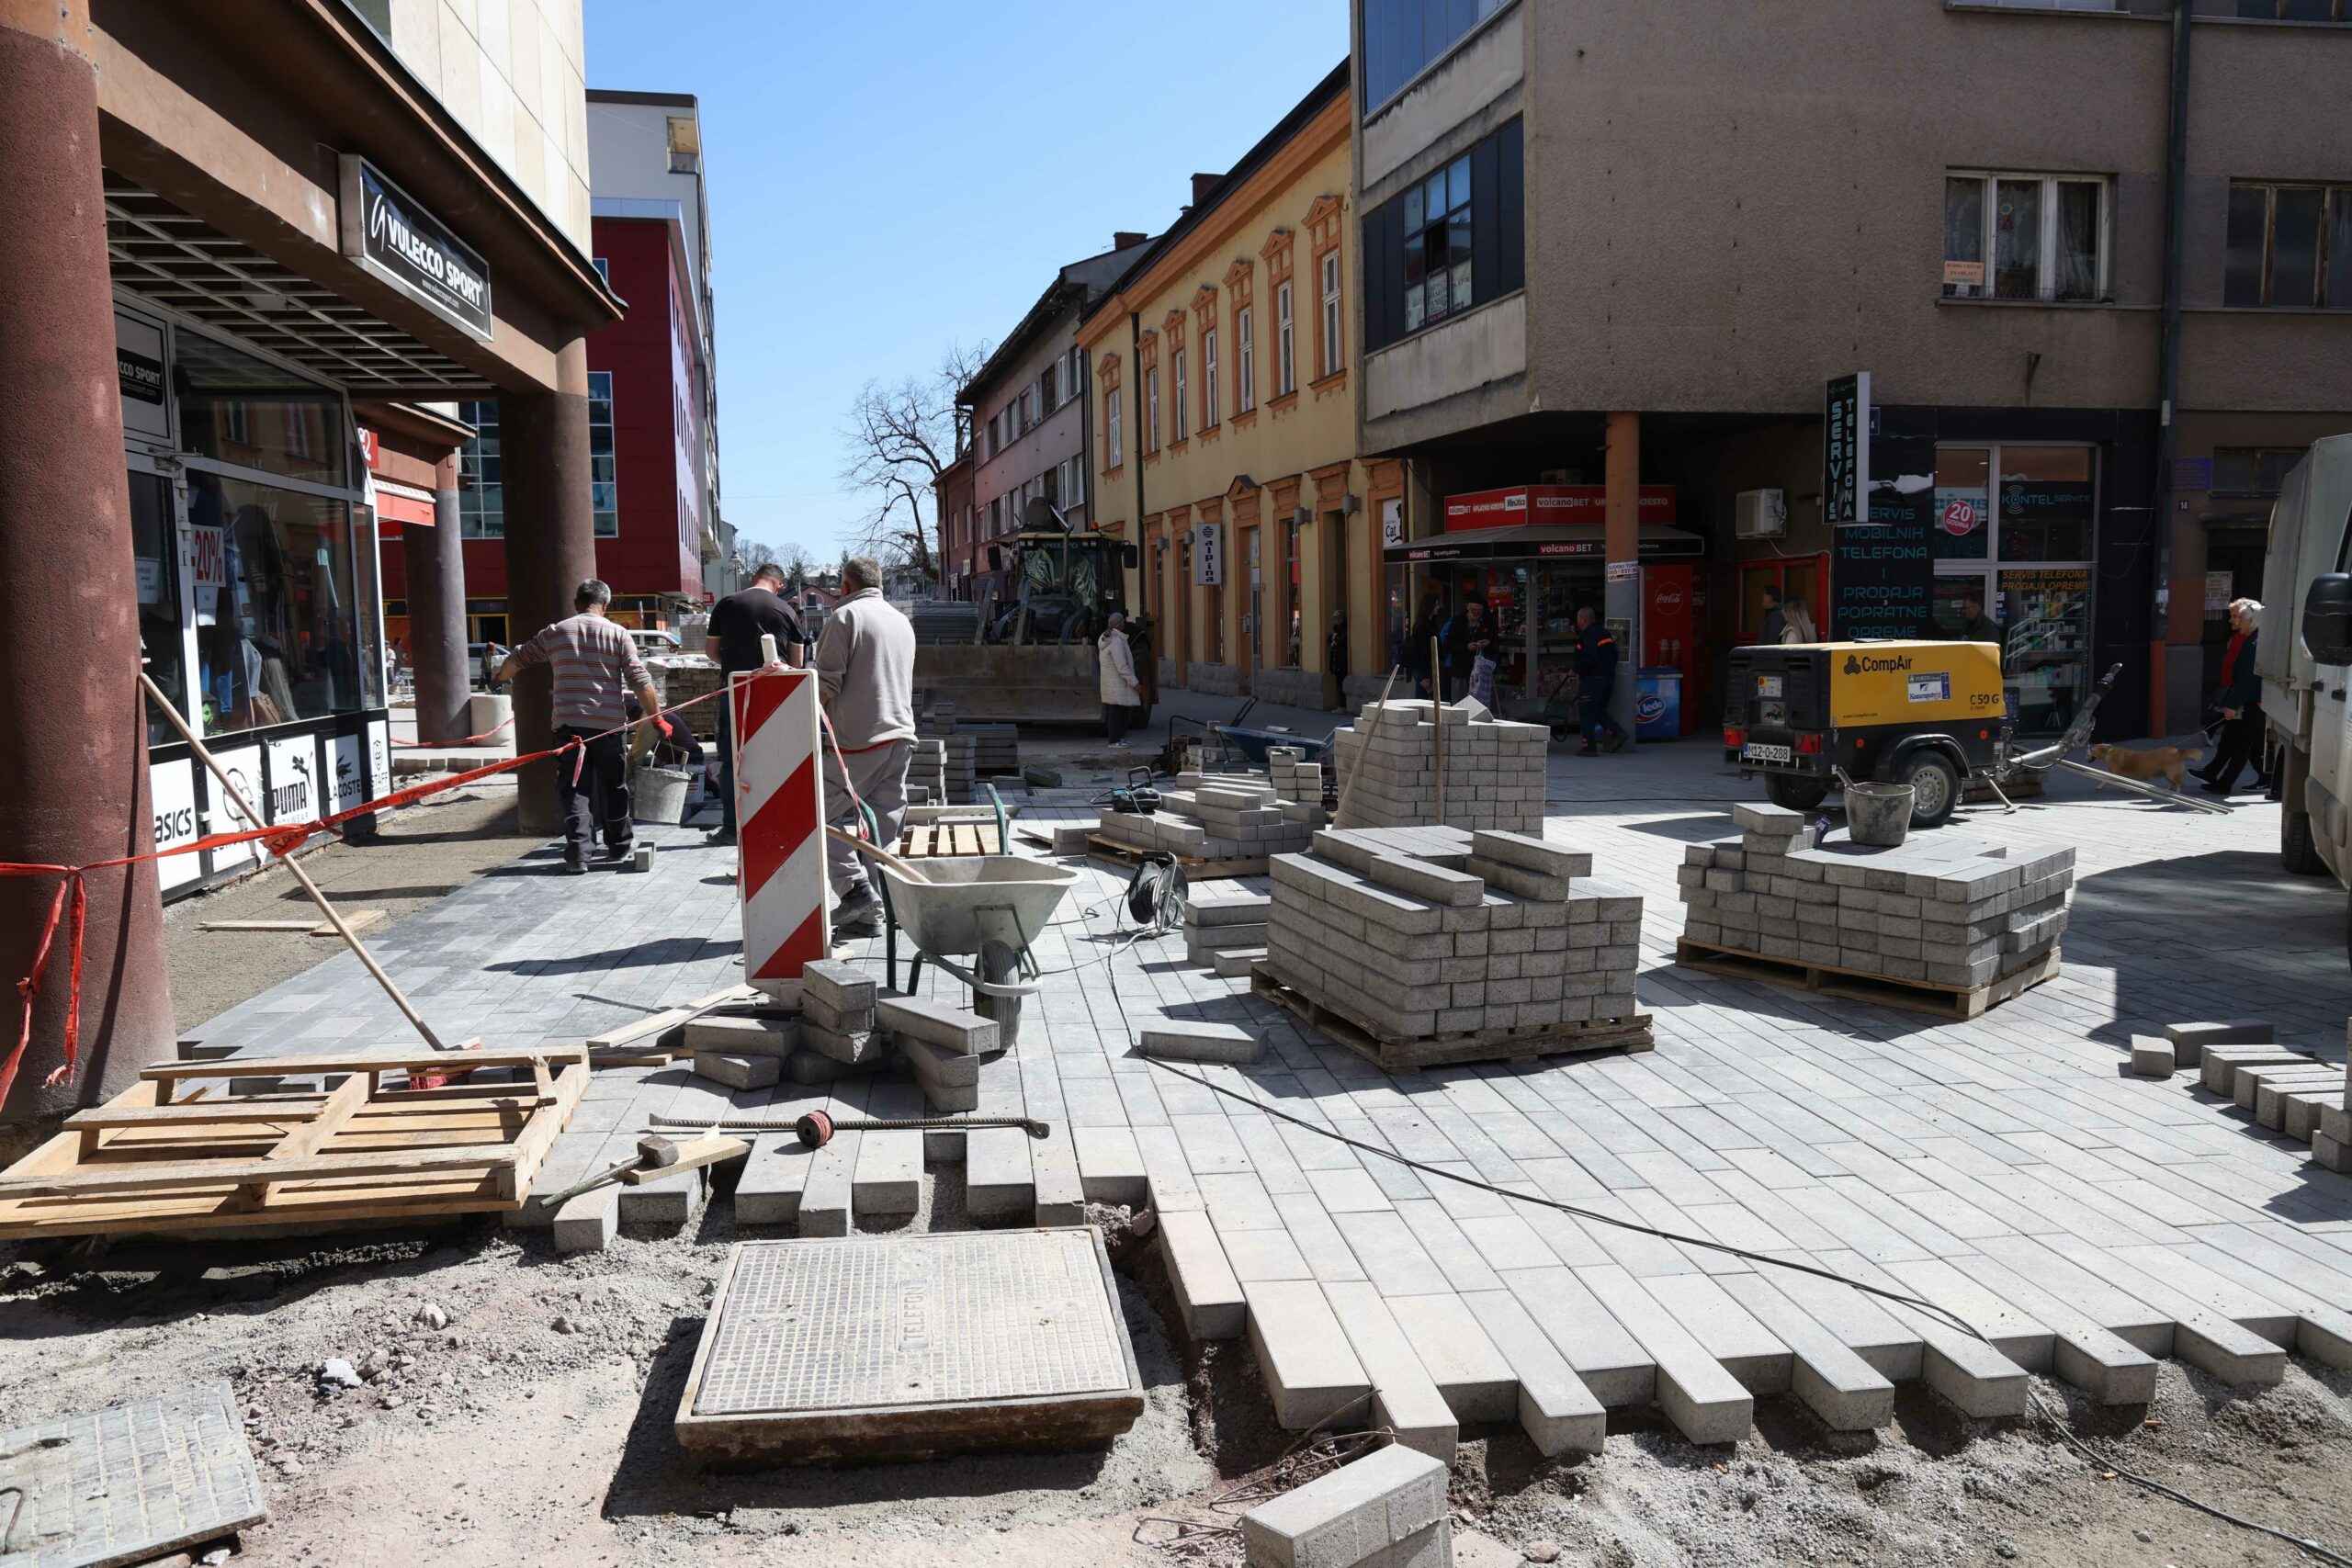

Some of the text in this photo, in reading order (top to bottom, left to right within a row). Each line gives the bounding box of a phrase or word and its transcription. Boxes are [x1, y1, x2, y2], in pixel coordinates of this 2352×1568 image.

[387, 213, 481, 307] VULECCO SPORT
[135, 366, 161, 386] SPORT
[1843, 398, 1854, 518] TELEFONA
[2002, 494, 2092, 505] KONTEL SERVICE
[1870, 507, 1915, 520] ERVIS
[1950, 503, 1971, 521] 20
[1946, 518, 1970, 529] GODINA
[1385, 525, 1396, 538] Cat
[1844, 527, 1924, 540] MOBILNIH
[191, 529, 223, 583] -20%
[1540, 543, 1575, 555] volcano
[1576, 543, 1592, 553] BET
[1839, 547, 1928, 559] TELEFONA
[1205, 540, 1215, 582] alpina
[2003, 570, 2088, 579] SERVIS TELEFONA
[1842, 586, 1923, 600] PRODAJA
[2001, 581, 2088, 591] PRODAJA OPREME
[1838, 606, 1928, 619] POPRATNE
[1847, 626, 1917, 639] OPREME
[1861, 655, 1913, 673] CompAir
[1642, 700, 1663, 714] ledo
[272, 781, 308, 816] PUMA
[154, 807, 192, 844] asics
[903, 1286, 925, 1341] TELEFON
